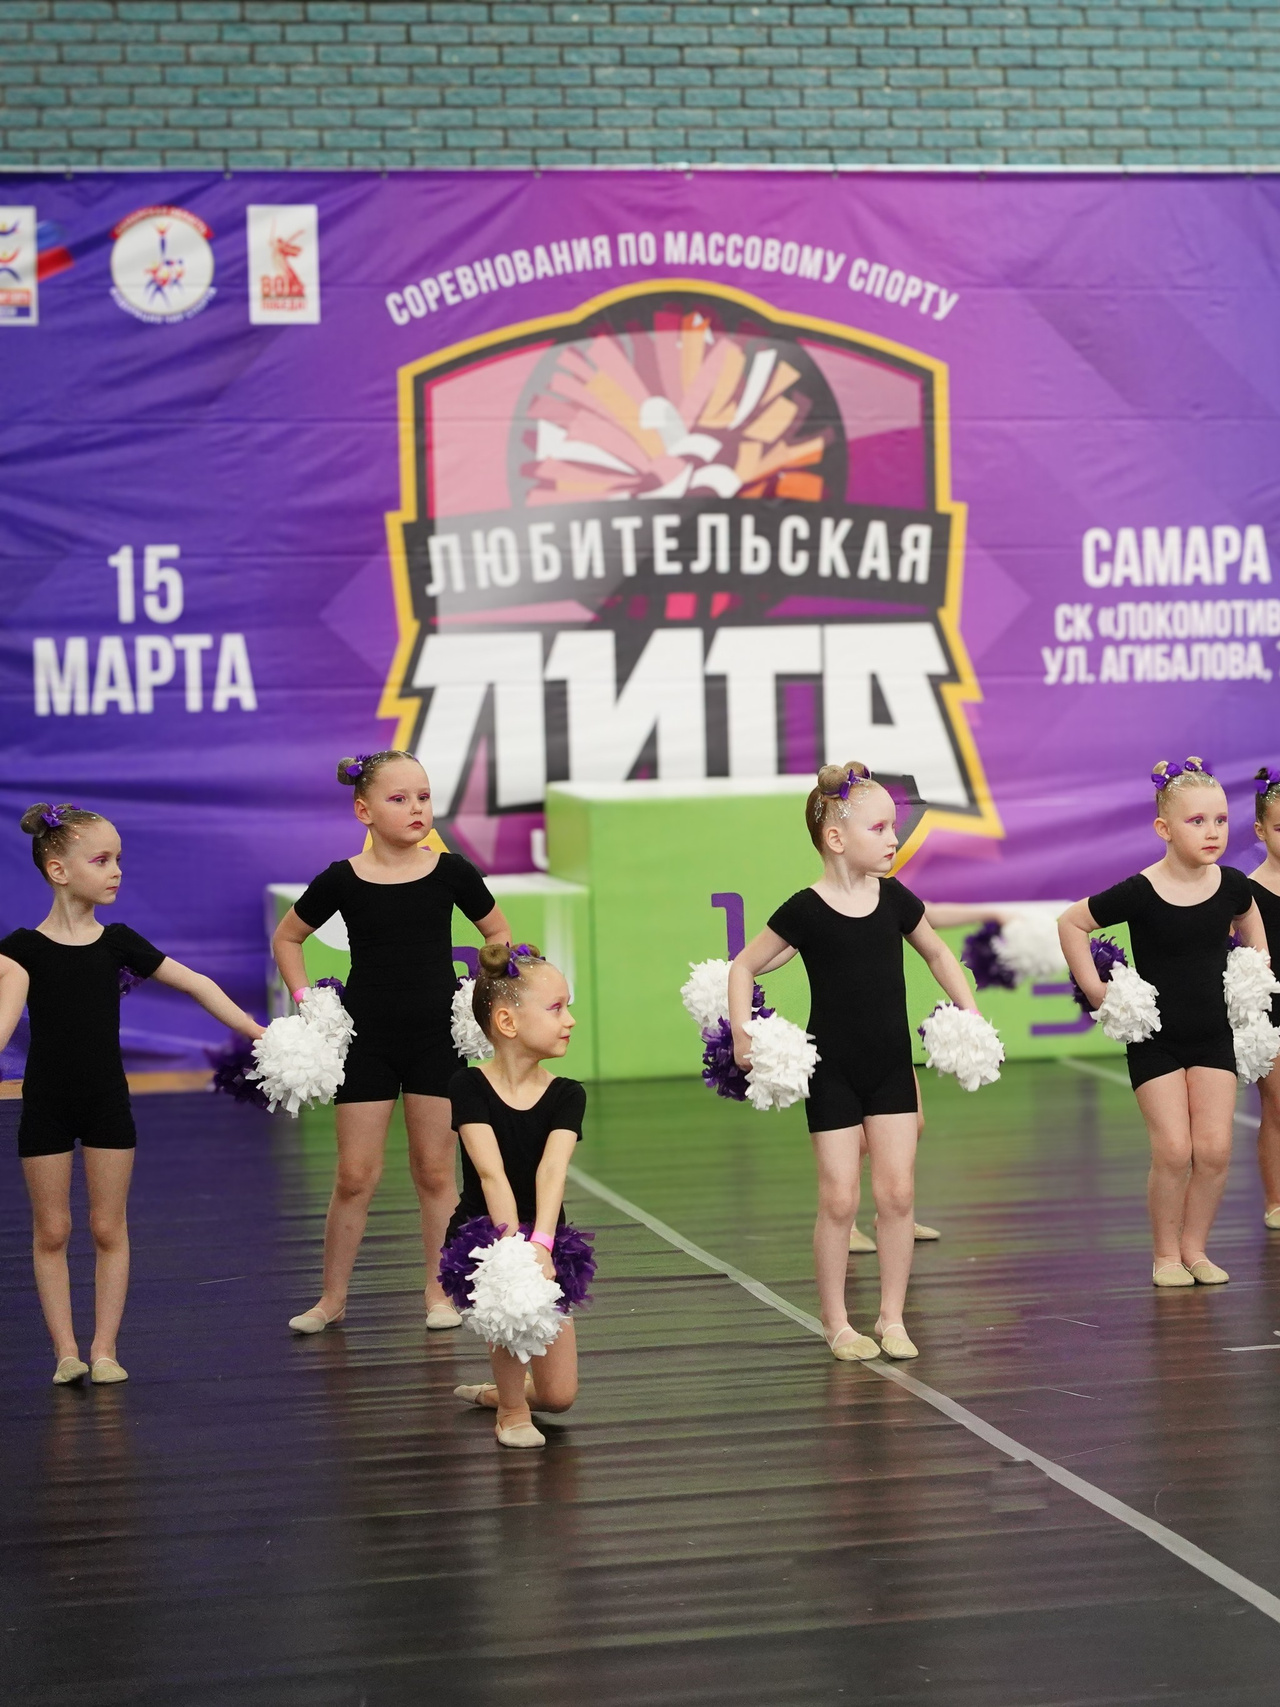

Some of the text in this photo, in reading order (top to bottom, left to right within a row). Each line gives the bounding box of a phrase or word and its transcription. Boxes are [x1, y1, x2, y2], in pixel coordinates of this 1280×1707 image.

[385, 231, 960, 326] СОРЕВНОВАНИЯ ПО МАССОВОМУ СПОРТУ
[107, 543, 185, 625] 15
[425, 513, 933, 597] ЛЮБИТЕЛЬСКАЯ
[1082, 523, 1273, 589] САМАРА
[1040, 646, 1096, 686] УЛ.
[1099, 640, 1274, 684] АГИБАЛОВА,
[1053, 602, 1095, 642] СК
[33, 632, 259, 717] МАРТА
[410, 621, 969, 819] ЛИГА
